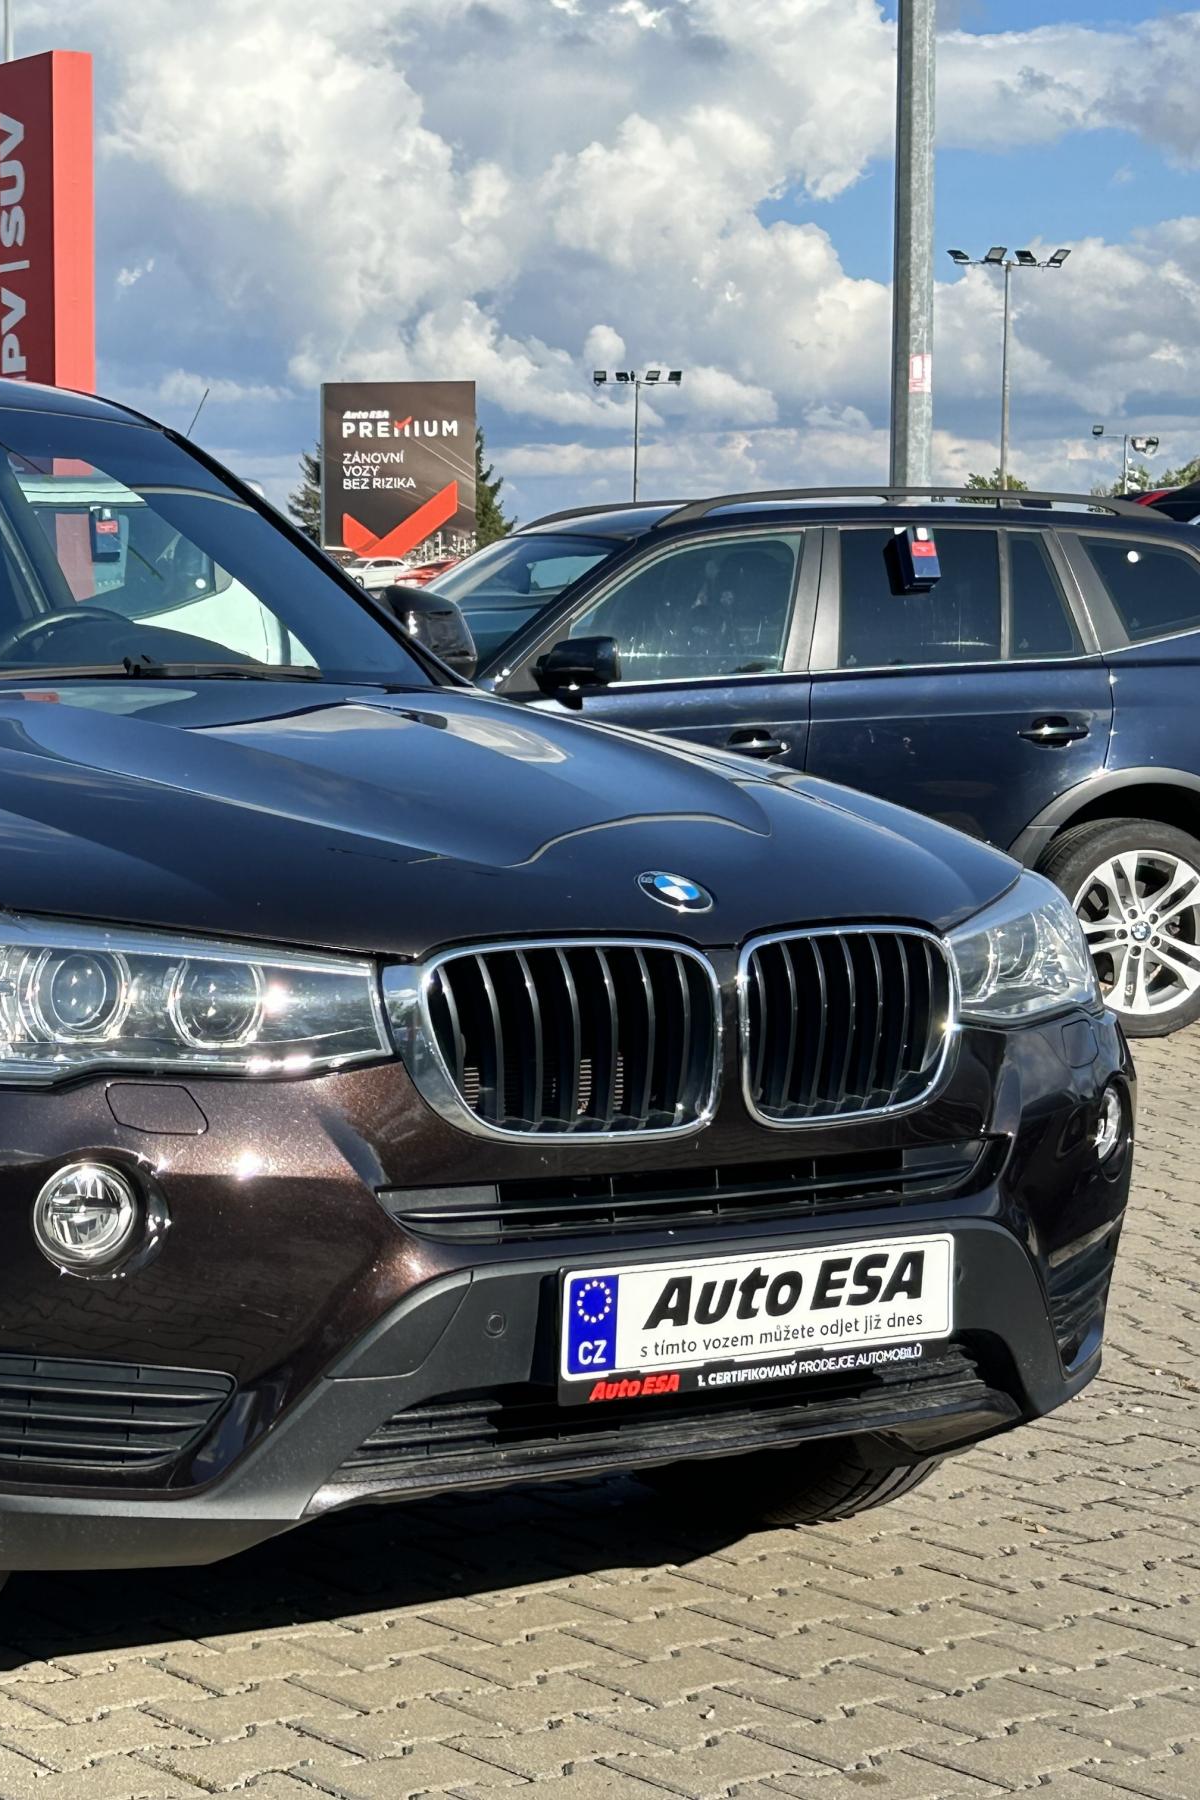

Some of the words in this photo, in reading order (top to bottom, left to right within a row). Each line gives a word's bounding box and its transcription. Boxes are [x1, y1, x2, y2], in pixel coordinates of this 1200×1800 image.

[0, 112, 25, 248] SUV
[342, 411, 369, 420] Auto
[369, 410, 390, 419] ESA
[342, 420, 458, 438] PREMIUM
[342, 450, 404, 465] ZÁNOVNÍ
[342, 465, 380, 477] VOZY
[342, 478, 370, 490] BEZ
[372, 477, 417, 489] RIZIKA
[642, 1266, 803, 1330] Auto
[810, 1250, 925, 1310] ESA
[640, 1346, 648, 1358] s
[654, 1339, 697, 1356] tímto
[703, 1334, 754, 1350] vozem
[759, 1325, 815, 1344] můžete
[820, 1317, 860, 1337] odjet
[887, 1312, 924, 1328] dnes
[578, 1340, 607, 1365] CZ
[708, 1361, 797, 1386] CERTIFIKOVANÝ
[799, 1354, 855, 1373] PRODEJCE
[856, 1343, 923, 1366] AUTOMOBILŮ
[589, 1380, 641, 1402] Auto
[641, 1374, 680, 1395] ESA
